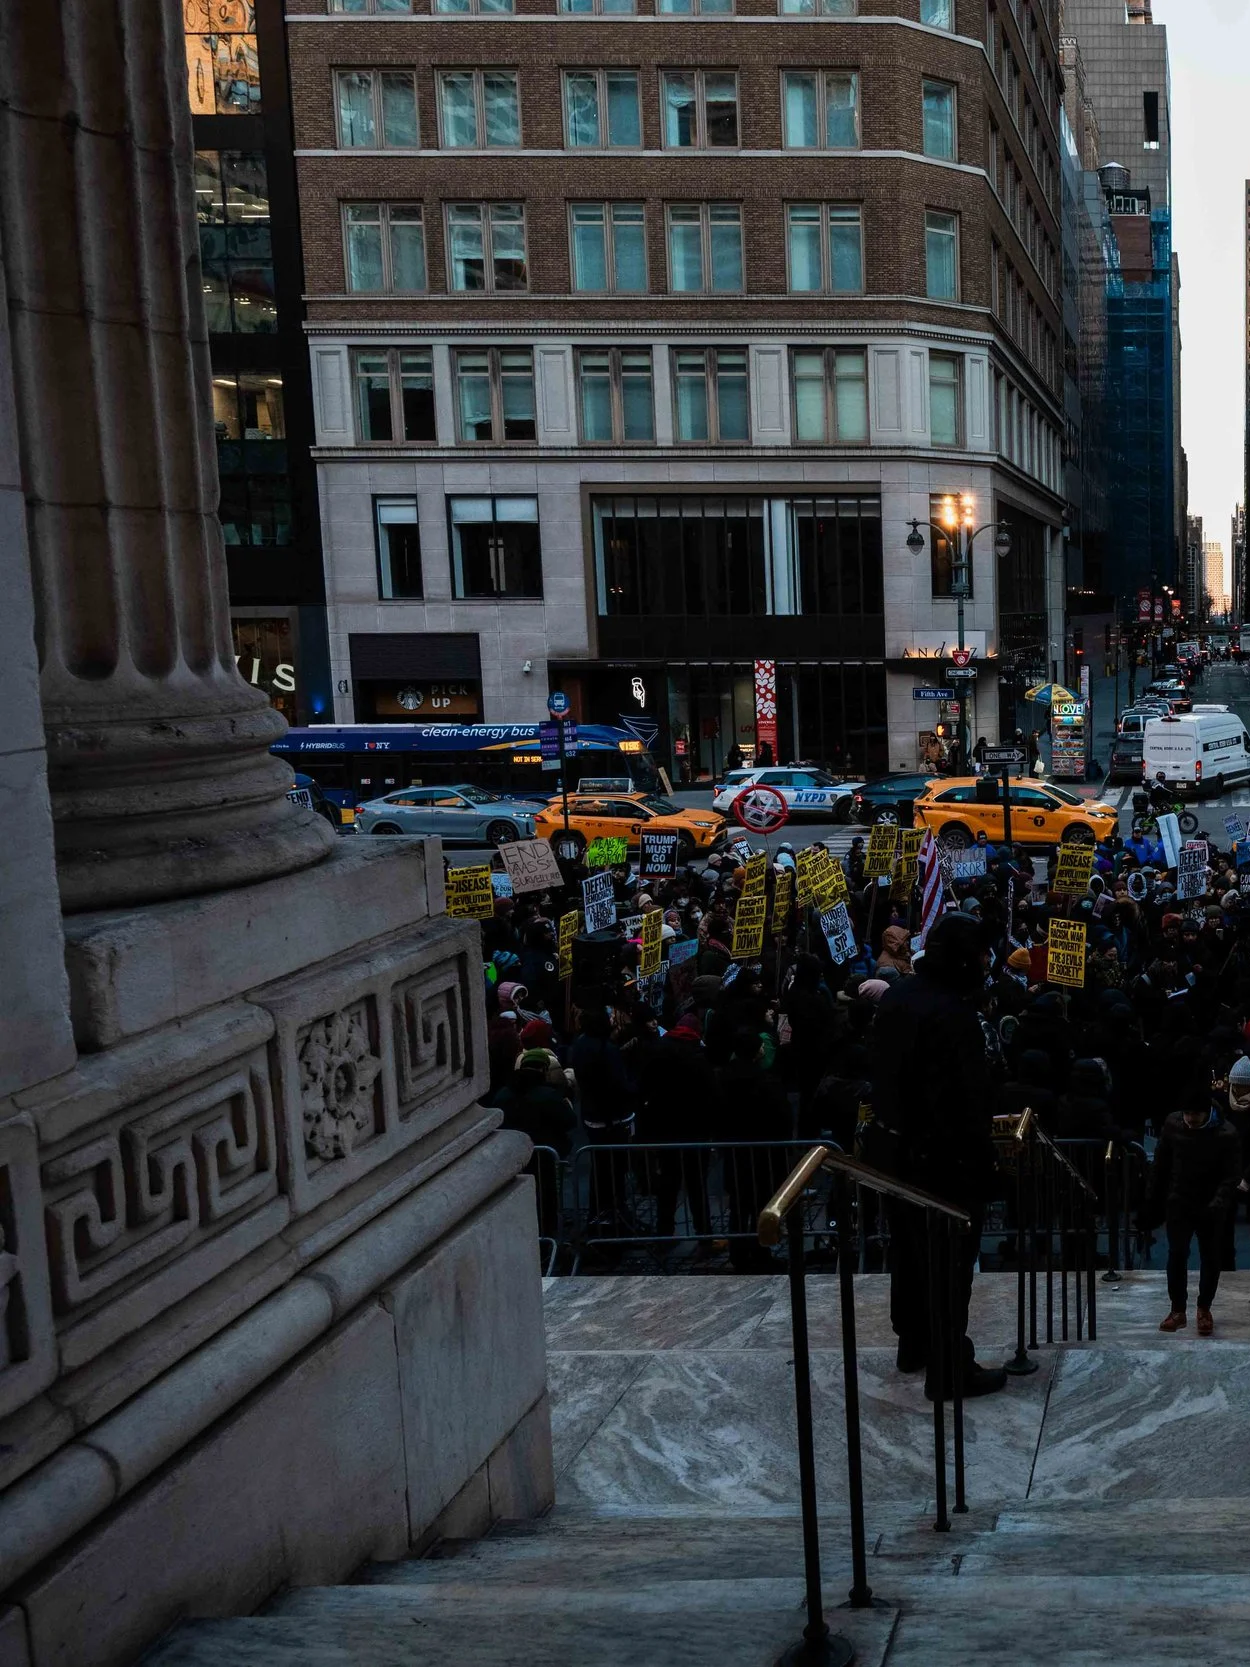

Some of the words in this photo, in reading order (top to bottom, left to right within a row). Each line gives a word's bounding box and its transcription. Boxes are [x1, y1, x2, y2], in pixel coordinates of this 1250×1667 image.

[235, 655, 296, 691] IS
[431, 685, 468, 696] PICK
[432, 698, 451, 708] UP
[422, 726, 509, 739] clean-energy
[511, 726, 535, 737] bus
[1007, 751, 1020, 759] WAY
[794, 793, 827, 803] NYPD
[643, 834, 677, 844] TRUMP
[503, 842, 549, 864] END
[645, 845, 673, 854] MUST
[651, 854, 666, 863] GO
[1060, 855, 1091, 868] DISEASE
[1179, 849, 1207, 866] DEFEND
[451, 867, 489, 876] RACISM
[645, 863, 672, 873] NOW!
[956, 861, 986, 877] RROR!
[452, 877, 489, 893] DISEASE
[584, 872, 612, 896] DEFEND
[1056, 880, 1088, 888] CURE!
[453, 893, 491, 906] REVOLUTION
[739, 897, 765, 906] FIGHT
[1051, 919, 1084, 931] FIGHT
[1071, 930, 1084, 942] WAR
[1065, 953, 1082, 966] EVILS
